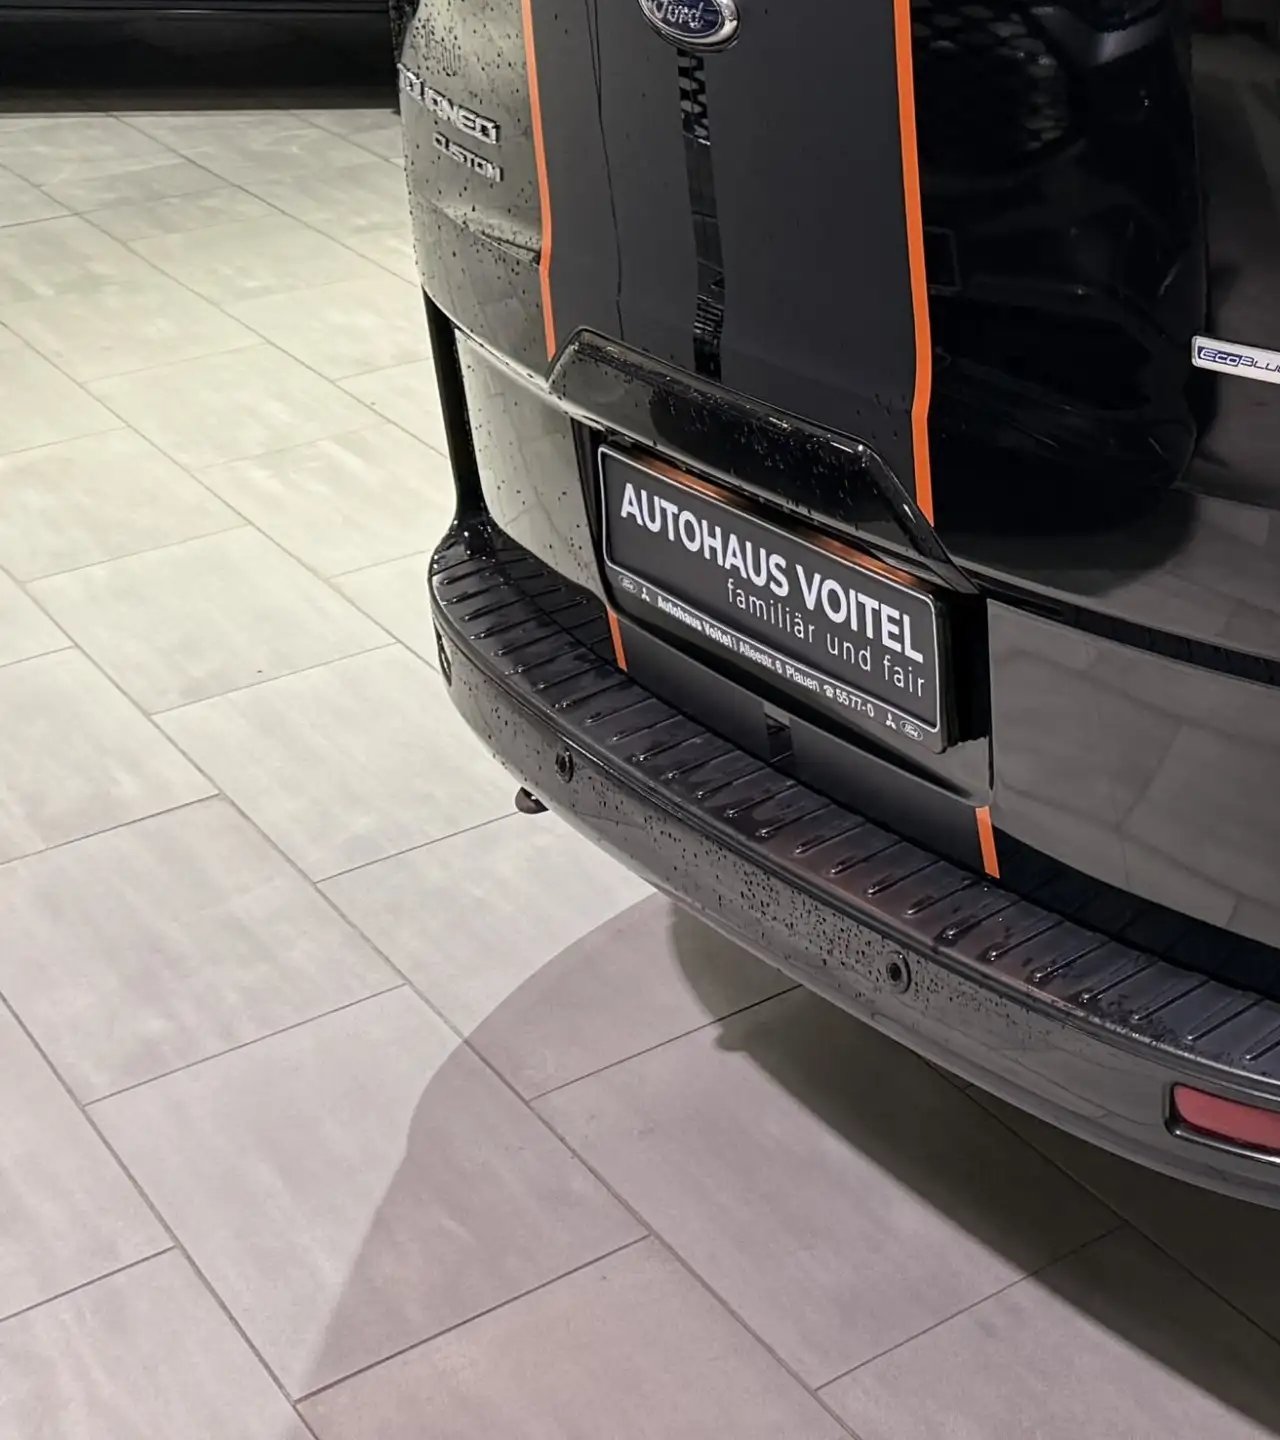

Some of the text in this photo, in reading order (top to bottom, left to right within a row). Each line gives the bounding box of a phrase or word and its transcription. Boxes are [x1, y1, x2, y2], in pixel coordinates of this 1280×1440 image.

[620, 482, 924, 664] AUTOHAUS VOITEL
[657, 595, 703, 632] Autohaus
[702, 620, 733, 648] Voitel
[785, 664, 820, 693] Plauen
[727, 578, 925, 697] familiär und fair
